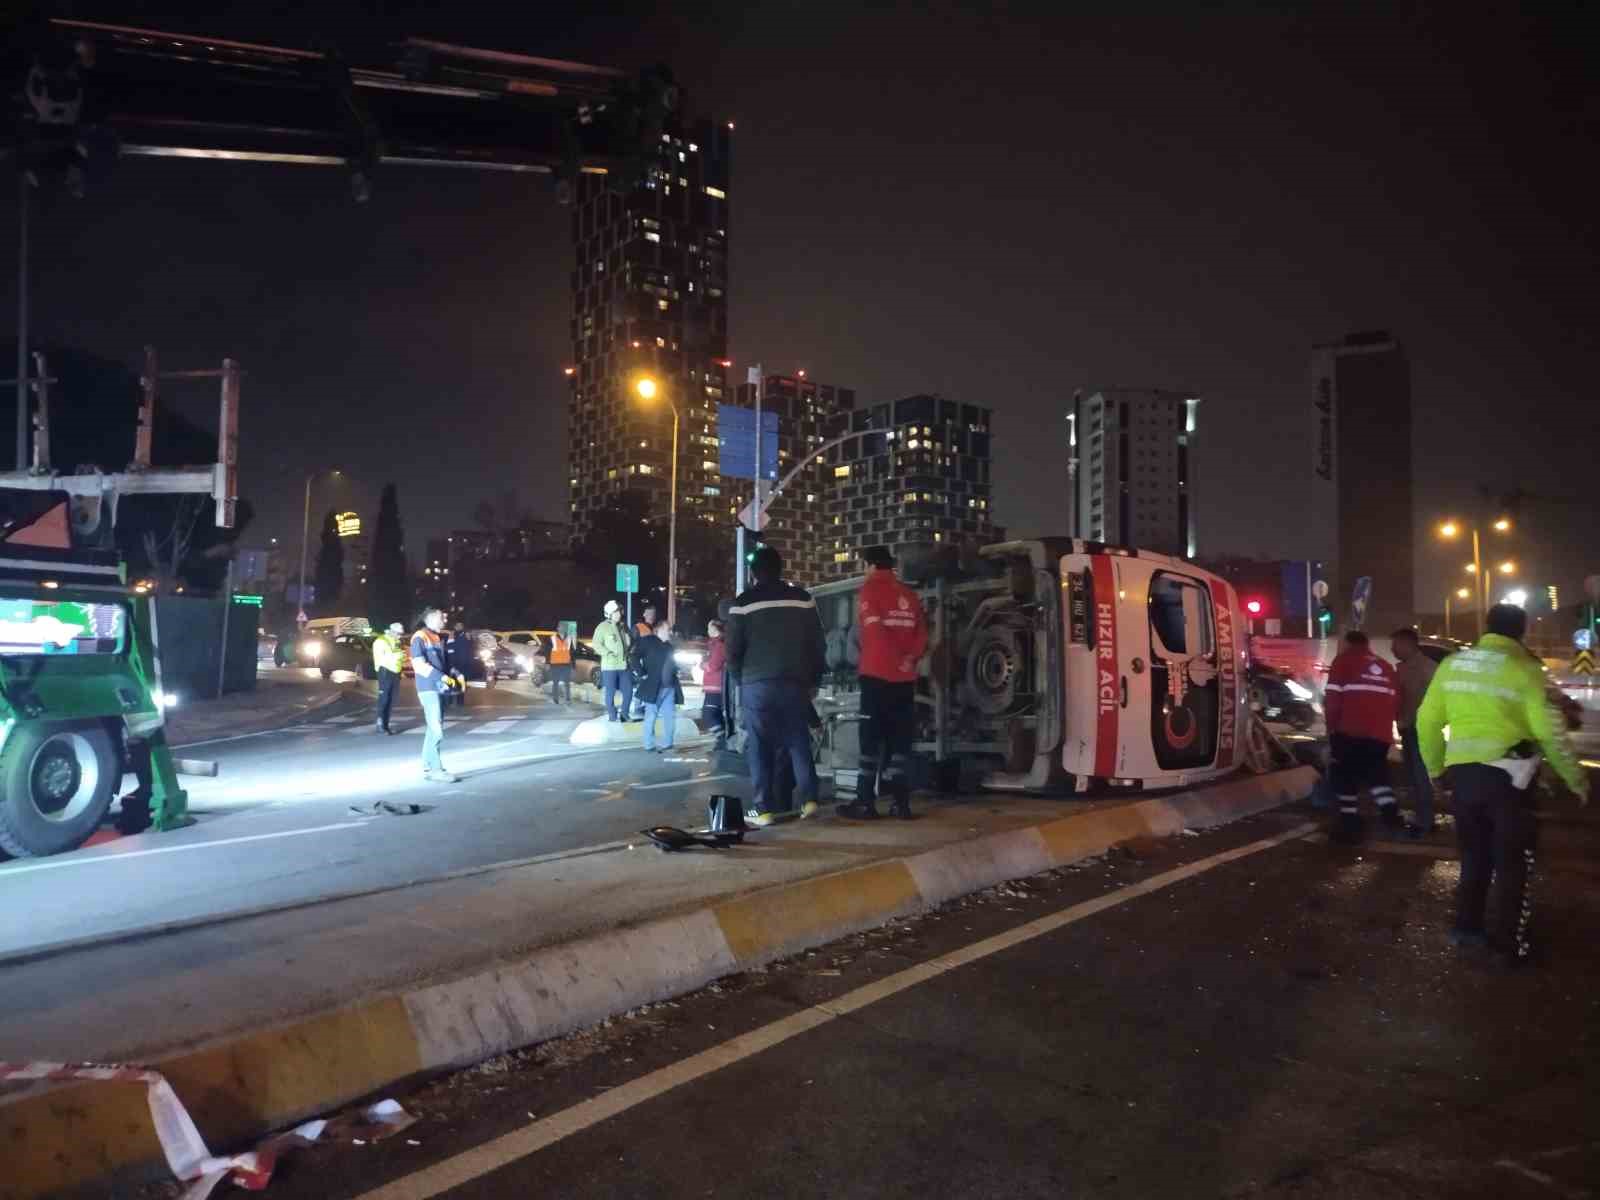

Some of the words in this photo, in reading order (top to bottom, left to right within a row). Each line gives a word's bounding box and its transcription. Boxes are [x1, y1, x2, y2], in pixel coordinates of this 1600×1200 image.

[1097, 603, 1114, 660] HIZIR
[1099, 669, 1117, 715] ACİL
[1216, 603, 1235, 750] AMBULANS
